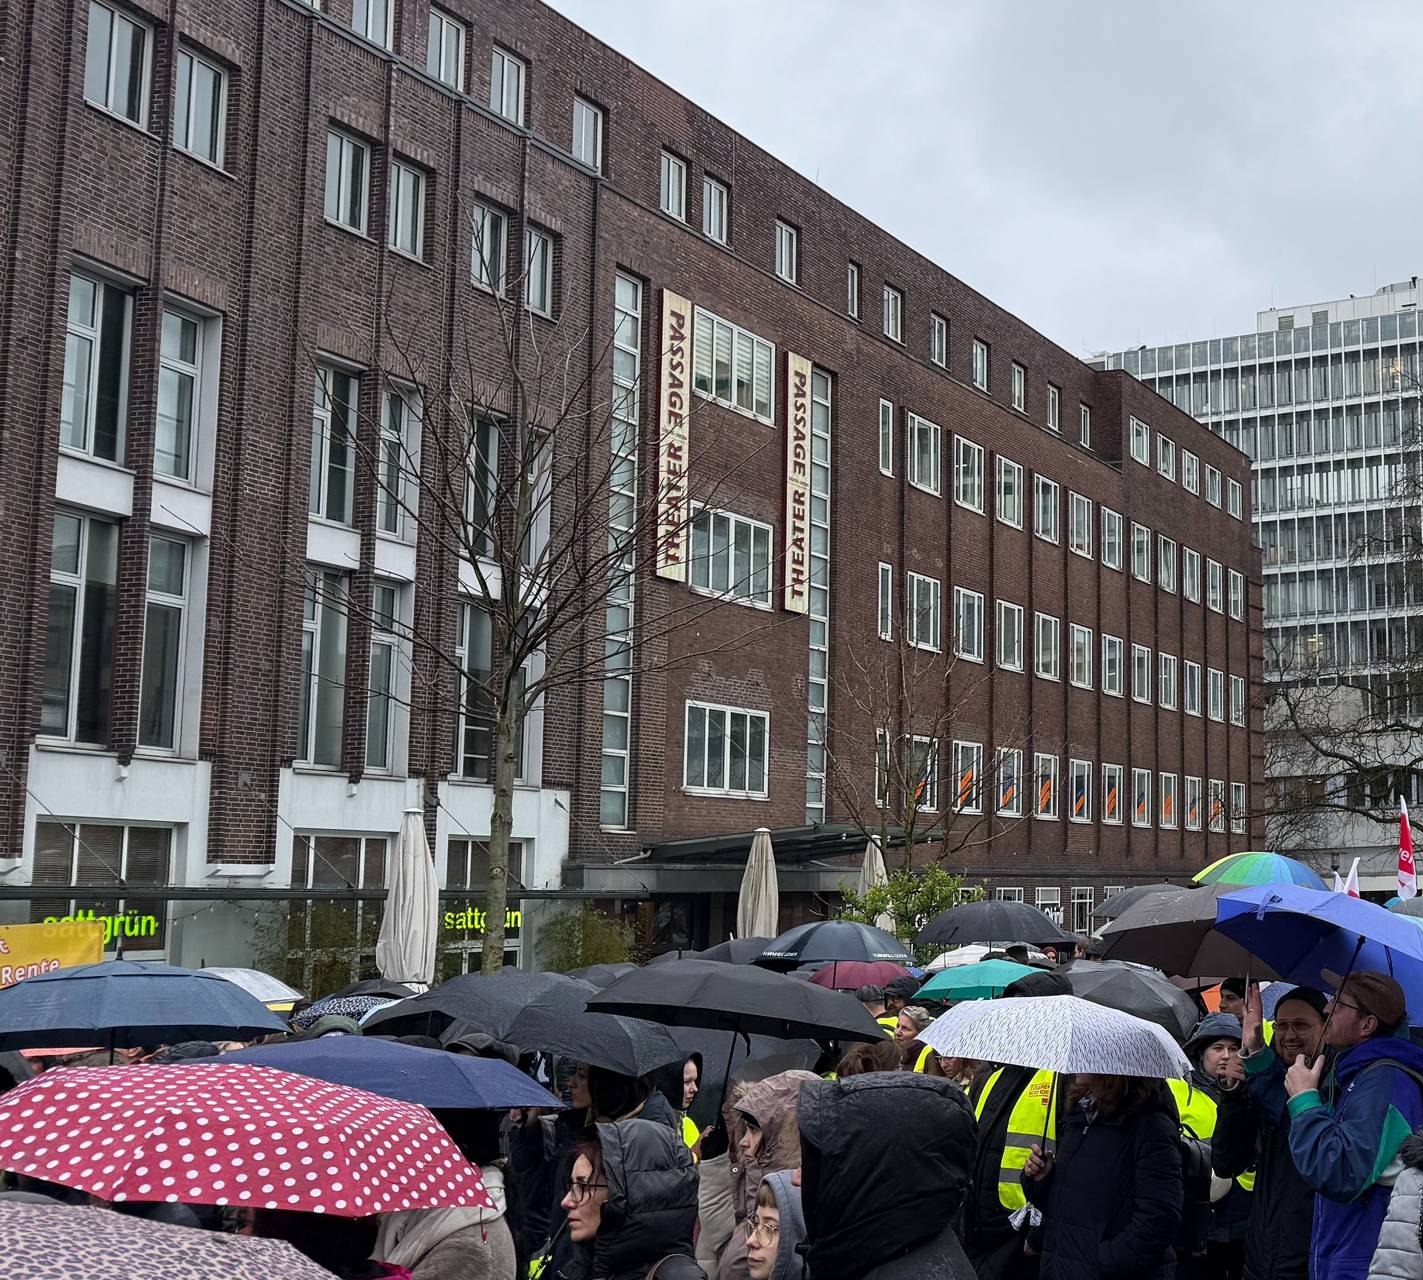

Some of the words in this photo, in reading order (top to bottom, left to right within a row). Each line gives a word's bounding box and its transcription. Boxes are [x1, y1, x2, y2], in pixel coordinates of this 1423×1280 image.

[668, 309, 686, 429] PASSAGE
[793, 370, 806, 476] PASSAGE
[791, 490, 805, 599] THEATER
[1, 959, 60, 985] Rente
